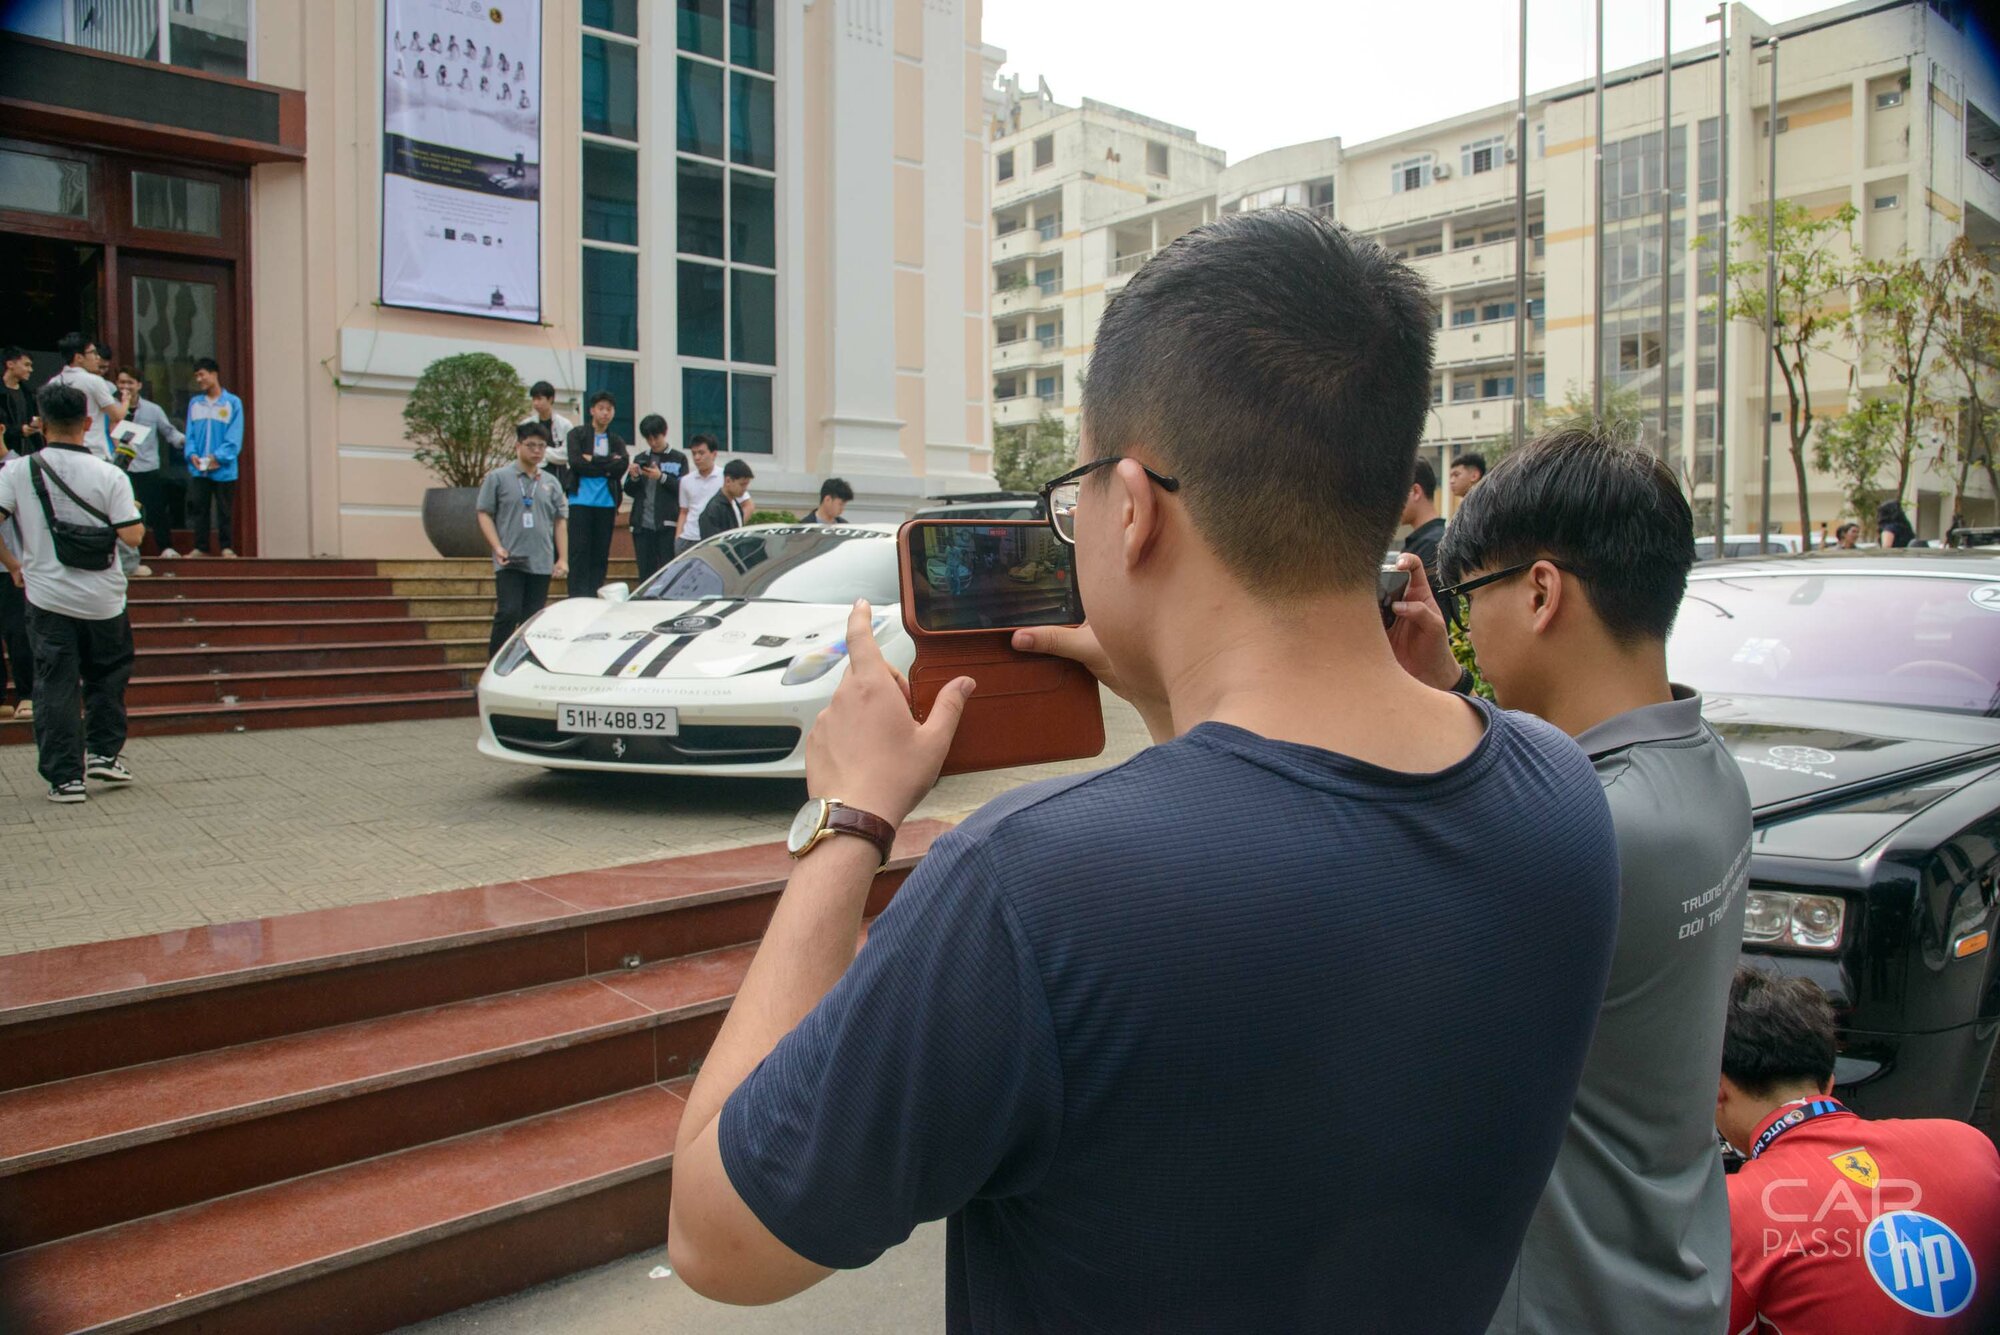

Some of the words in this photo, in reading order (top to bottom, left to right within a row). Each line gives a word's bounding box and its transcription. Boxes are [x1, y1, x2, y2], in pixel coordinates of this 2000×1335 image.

[821, 528, 892, 539] COFFE
[566, 709, 667, 730] 51H-488.92
[1762, 1120, 1787, 1142] UTC
[1882, 1214, 1956, 1314] hp
